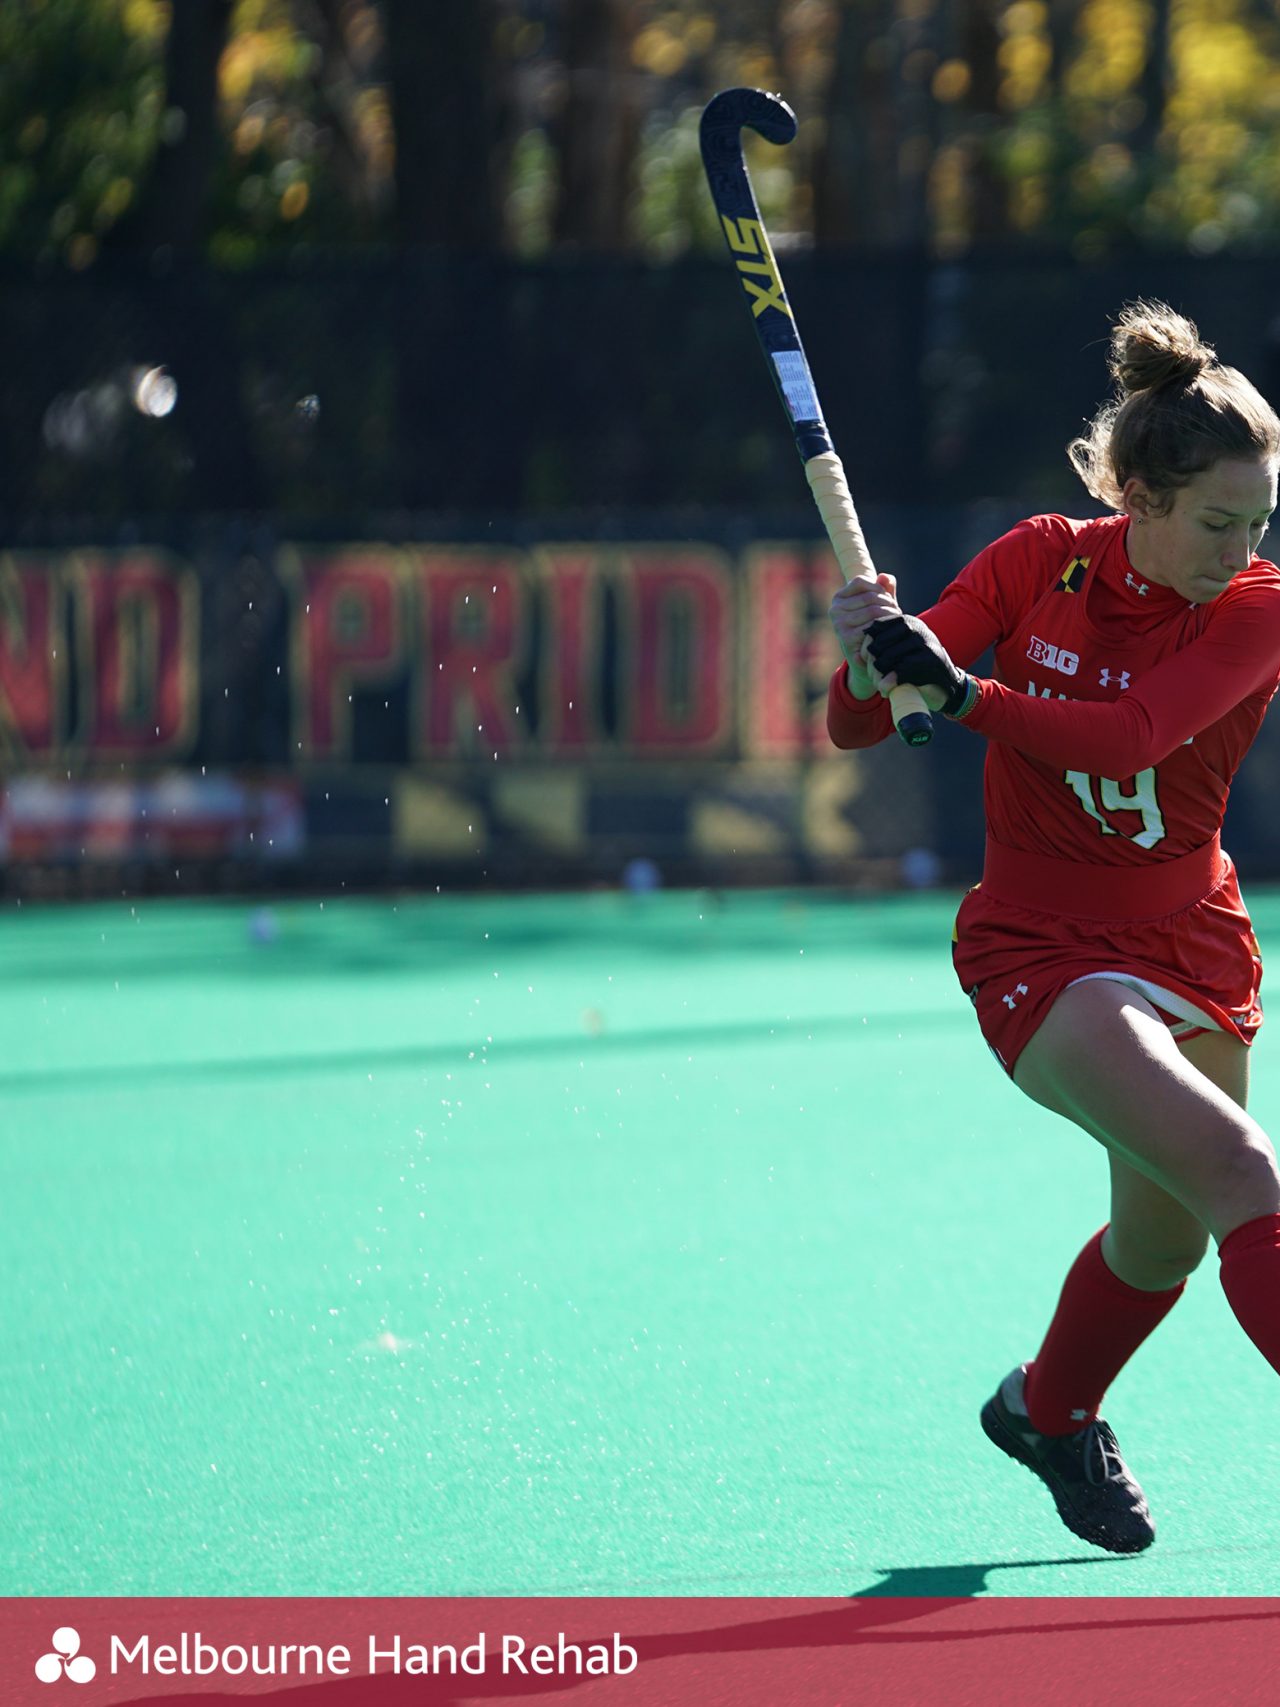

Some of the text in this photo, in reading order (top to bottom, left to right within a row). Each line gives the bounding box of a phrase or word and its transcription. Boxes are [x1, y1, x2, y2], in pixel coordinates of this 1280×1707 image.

[721, 214, 793, 319] STX
[288, 545, 843, 757] PRIDE
[1064, 766, 1166, 850] 19
